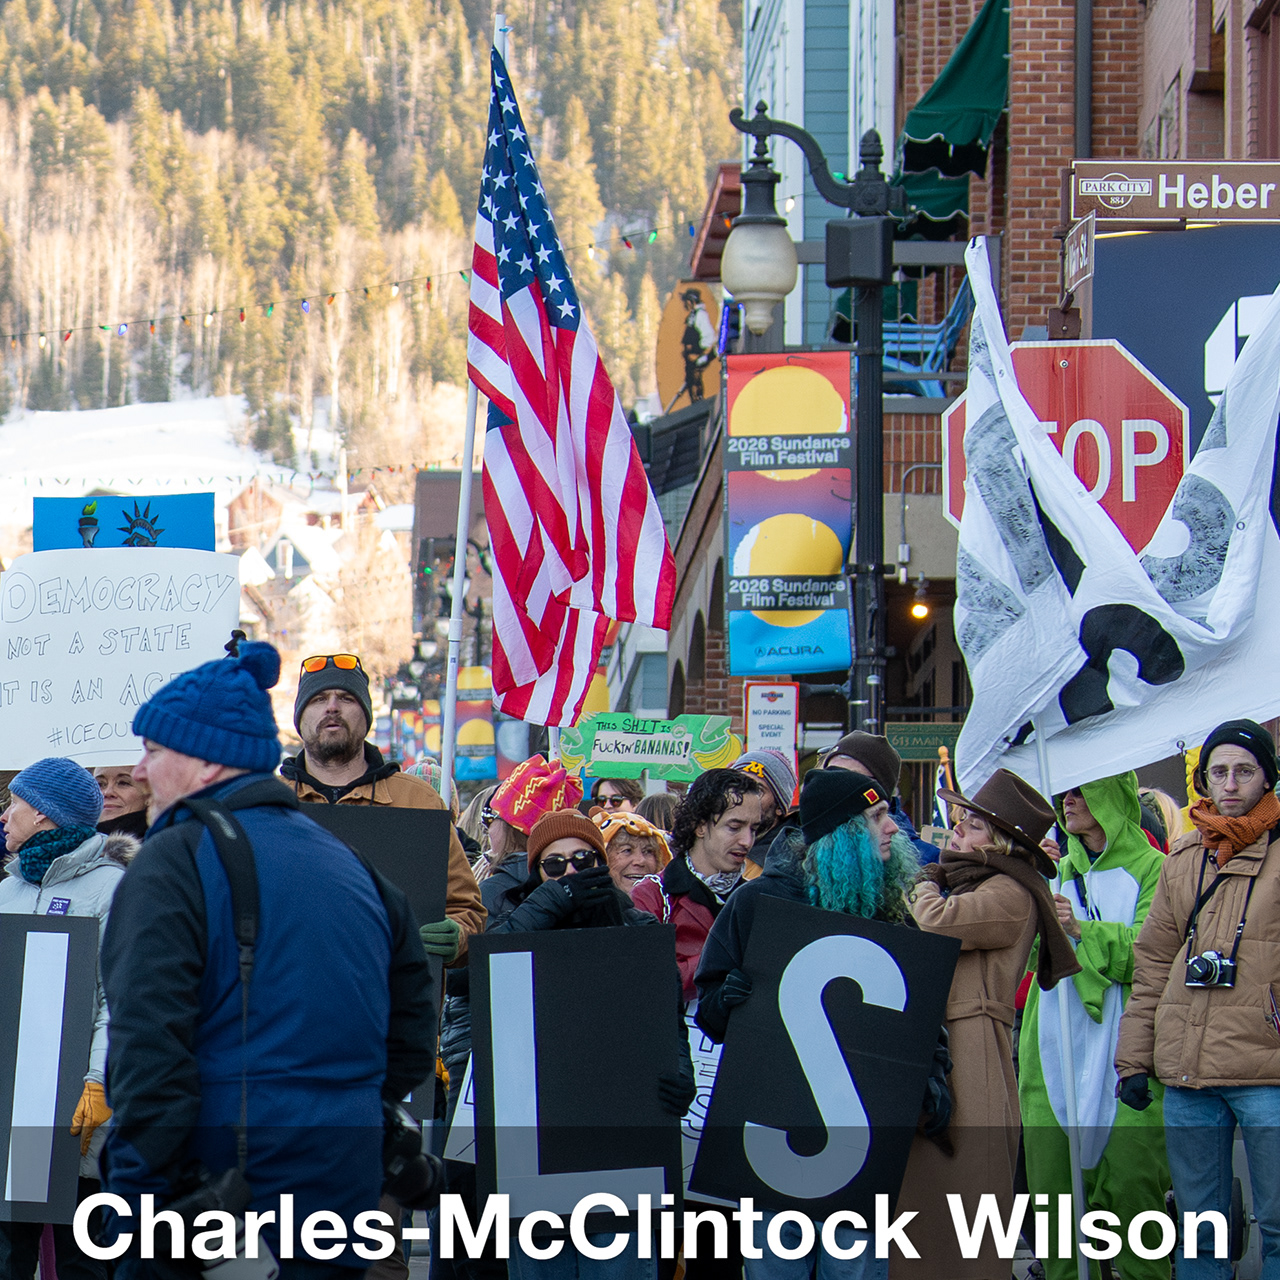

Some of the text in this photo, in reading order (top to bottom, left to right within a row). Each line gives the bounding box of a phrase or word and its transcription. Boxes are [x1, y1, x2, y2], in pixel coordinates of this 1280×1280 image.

[1084, 182, 1147, 192] PARK CITY
[1158, 174, 1276, 210] Heber
[728, 436, 851, 452] 2026 Sundance
[740, 450, 839, 466] Film Festival
[1040, 419, 1170, 502] OP
[729, 577, 846, 593] 2026 Sundance
[0, 570, 236, 624] DEMOCRACY
[742, 592, 835, 607] Film Festival
[7, 633, 51, 660] NOT
[68, 630, 85, 655] A
[98, 622, 192, 656] STATE
[767, 644, 825, 656] ACURA
[30, 678, 53, 705] IS
[71, 677, 103, 705] AN
[119, 671, 184, 706] AC
[596, 721, 617, 731] THIS
[622, 718, 661, 733] SHIT
[633, 739, 690, 758] BANANAS!
[911, 736, 943, 746] MAIN
